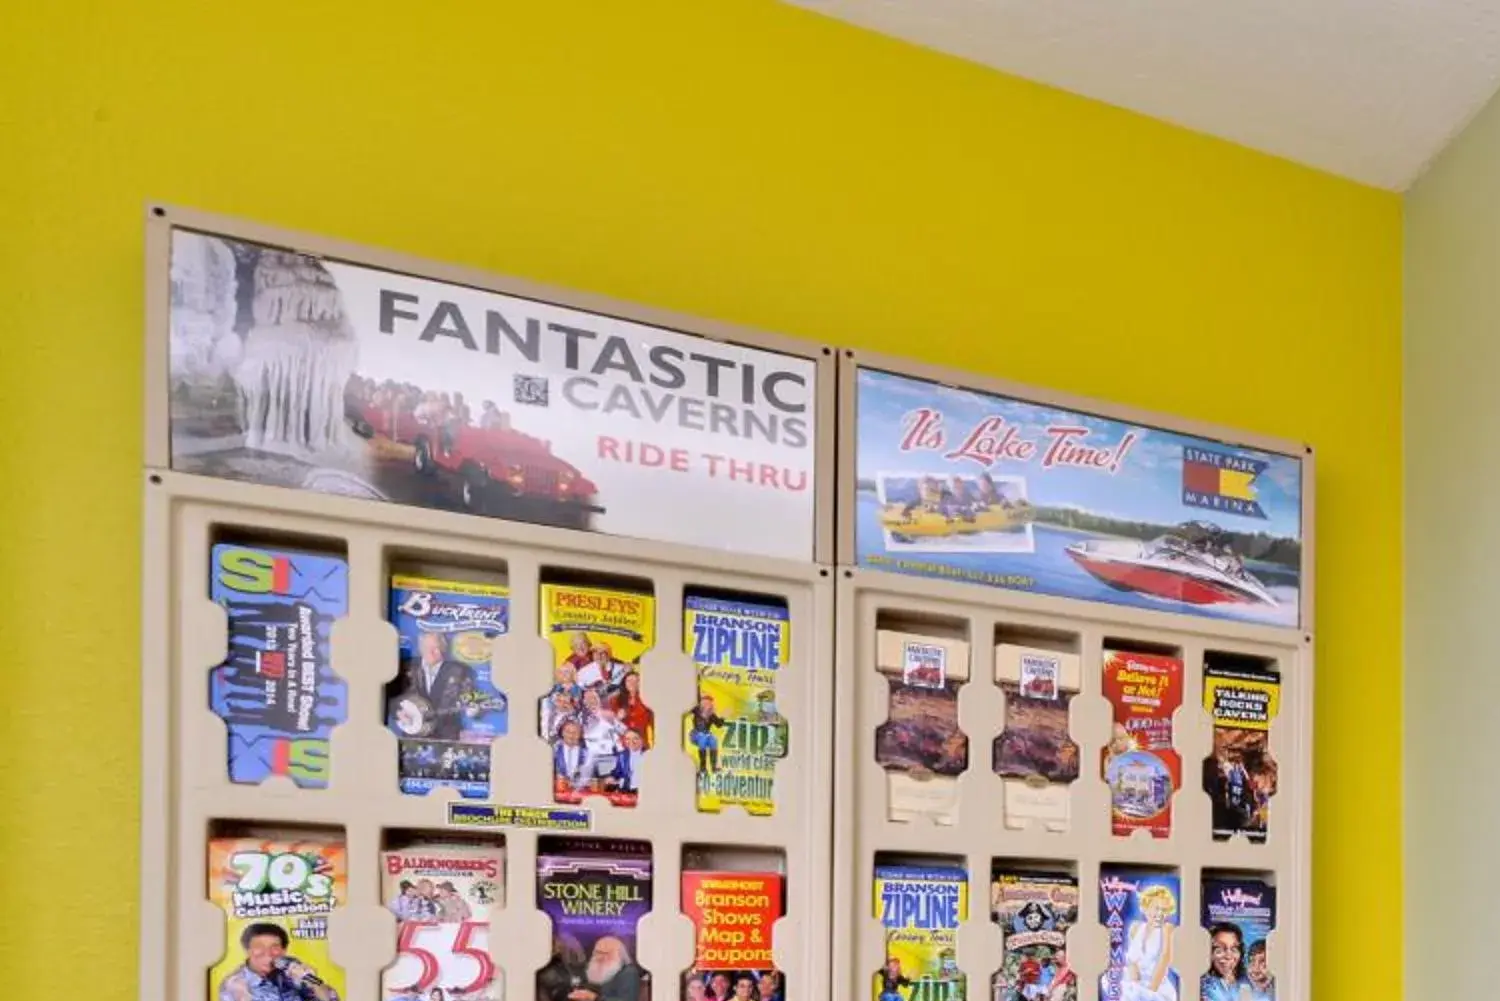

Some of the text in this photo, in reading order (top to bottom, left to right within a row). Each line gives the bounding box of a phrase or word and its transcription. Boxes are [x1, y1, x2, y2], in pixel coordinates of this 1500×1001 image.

[379, 288, 806, 414] FANTASTIC
[562, 377, 807, 449] CAVERNS
[945, 416, 1037, 467] Lake
[1042, 426, 1136, 473] Time!
[598, 436, 807, 492] RIDE THRU
[1184, 447, 1257, 473] STATE PARK
[1184, 491, 1257, 514] MARINA
[695, 613, 781, 634] BRANSON
[694, 624, 781, 670] ZIPLINE
[1216, 689, 1269, 703] TALKING
[1219, 699, 1263, 710] ROCKS
[233, 888, 304, 906] Music
[543, 882, 645, 901] STONE HILL
[695, 889, 769, 908] Branson
[883, 882, 959, 894] BRANSON
[561, 899, 626, 916] WINERY
[702, 908, 763, 926] Shows
[881, 893, 960, 929] ZIPLINE
[698, 927, 763, 947] Map &
[388, 920, 496, 994] 55
